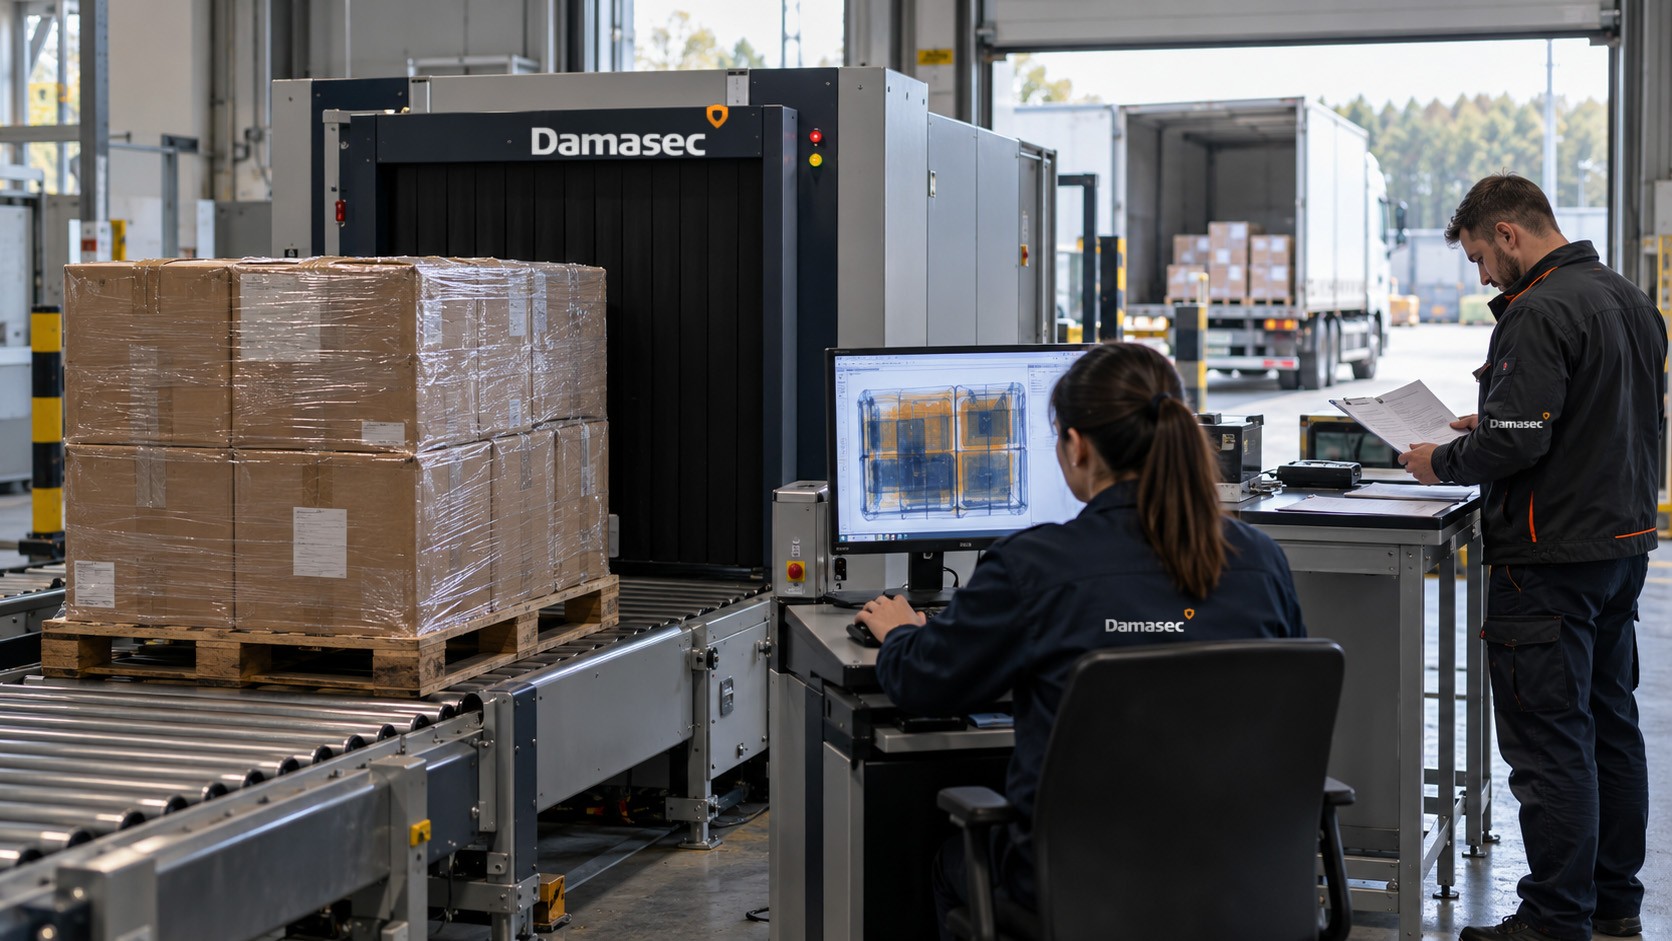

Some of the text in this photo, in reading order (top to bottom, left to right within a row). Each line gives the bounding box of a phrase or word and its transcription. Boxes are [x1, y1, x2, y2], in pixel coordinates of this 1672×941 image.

[531, 127, 706, 156] Damasec
[1489, 419, 1544, 429] Damasec
[1105, 618, 1185, 633] Damasec
